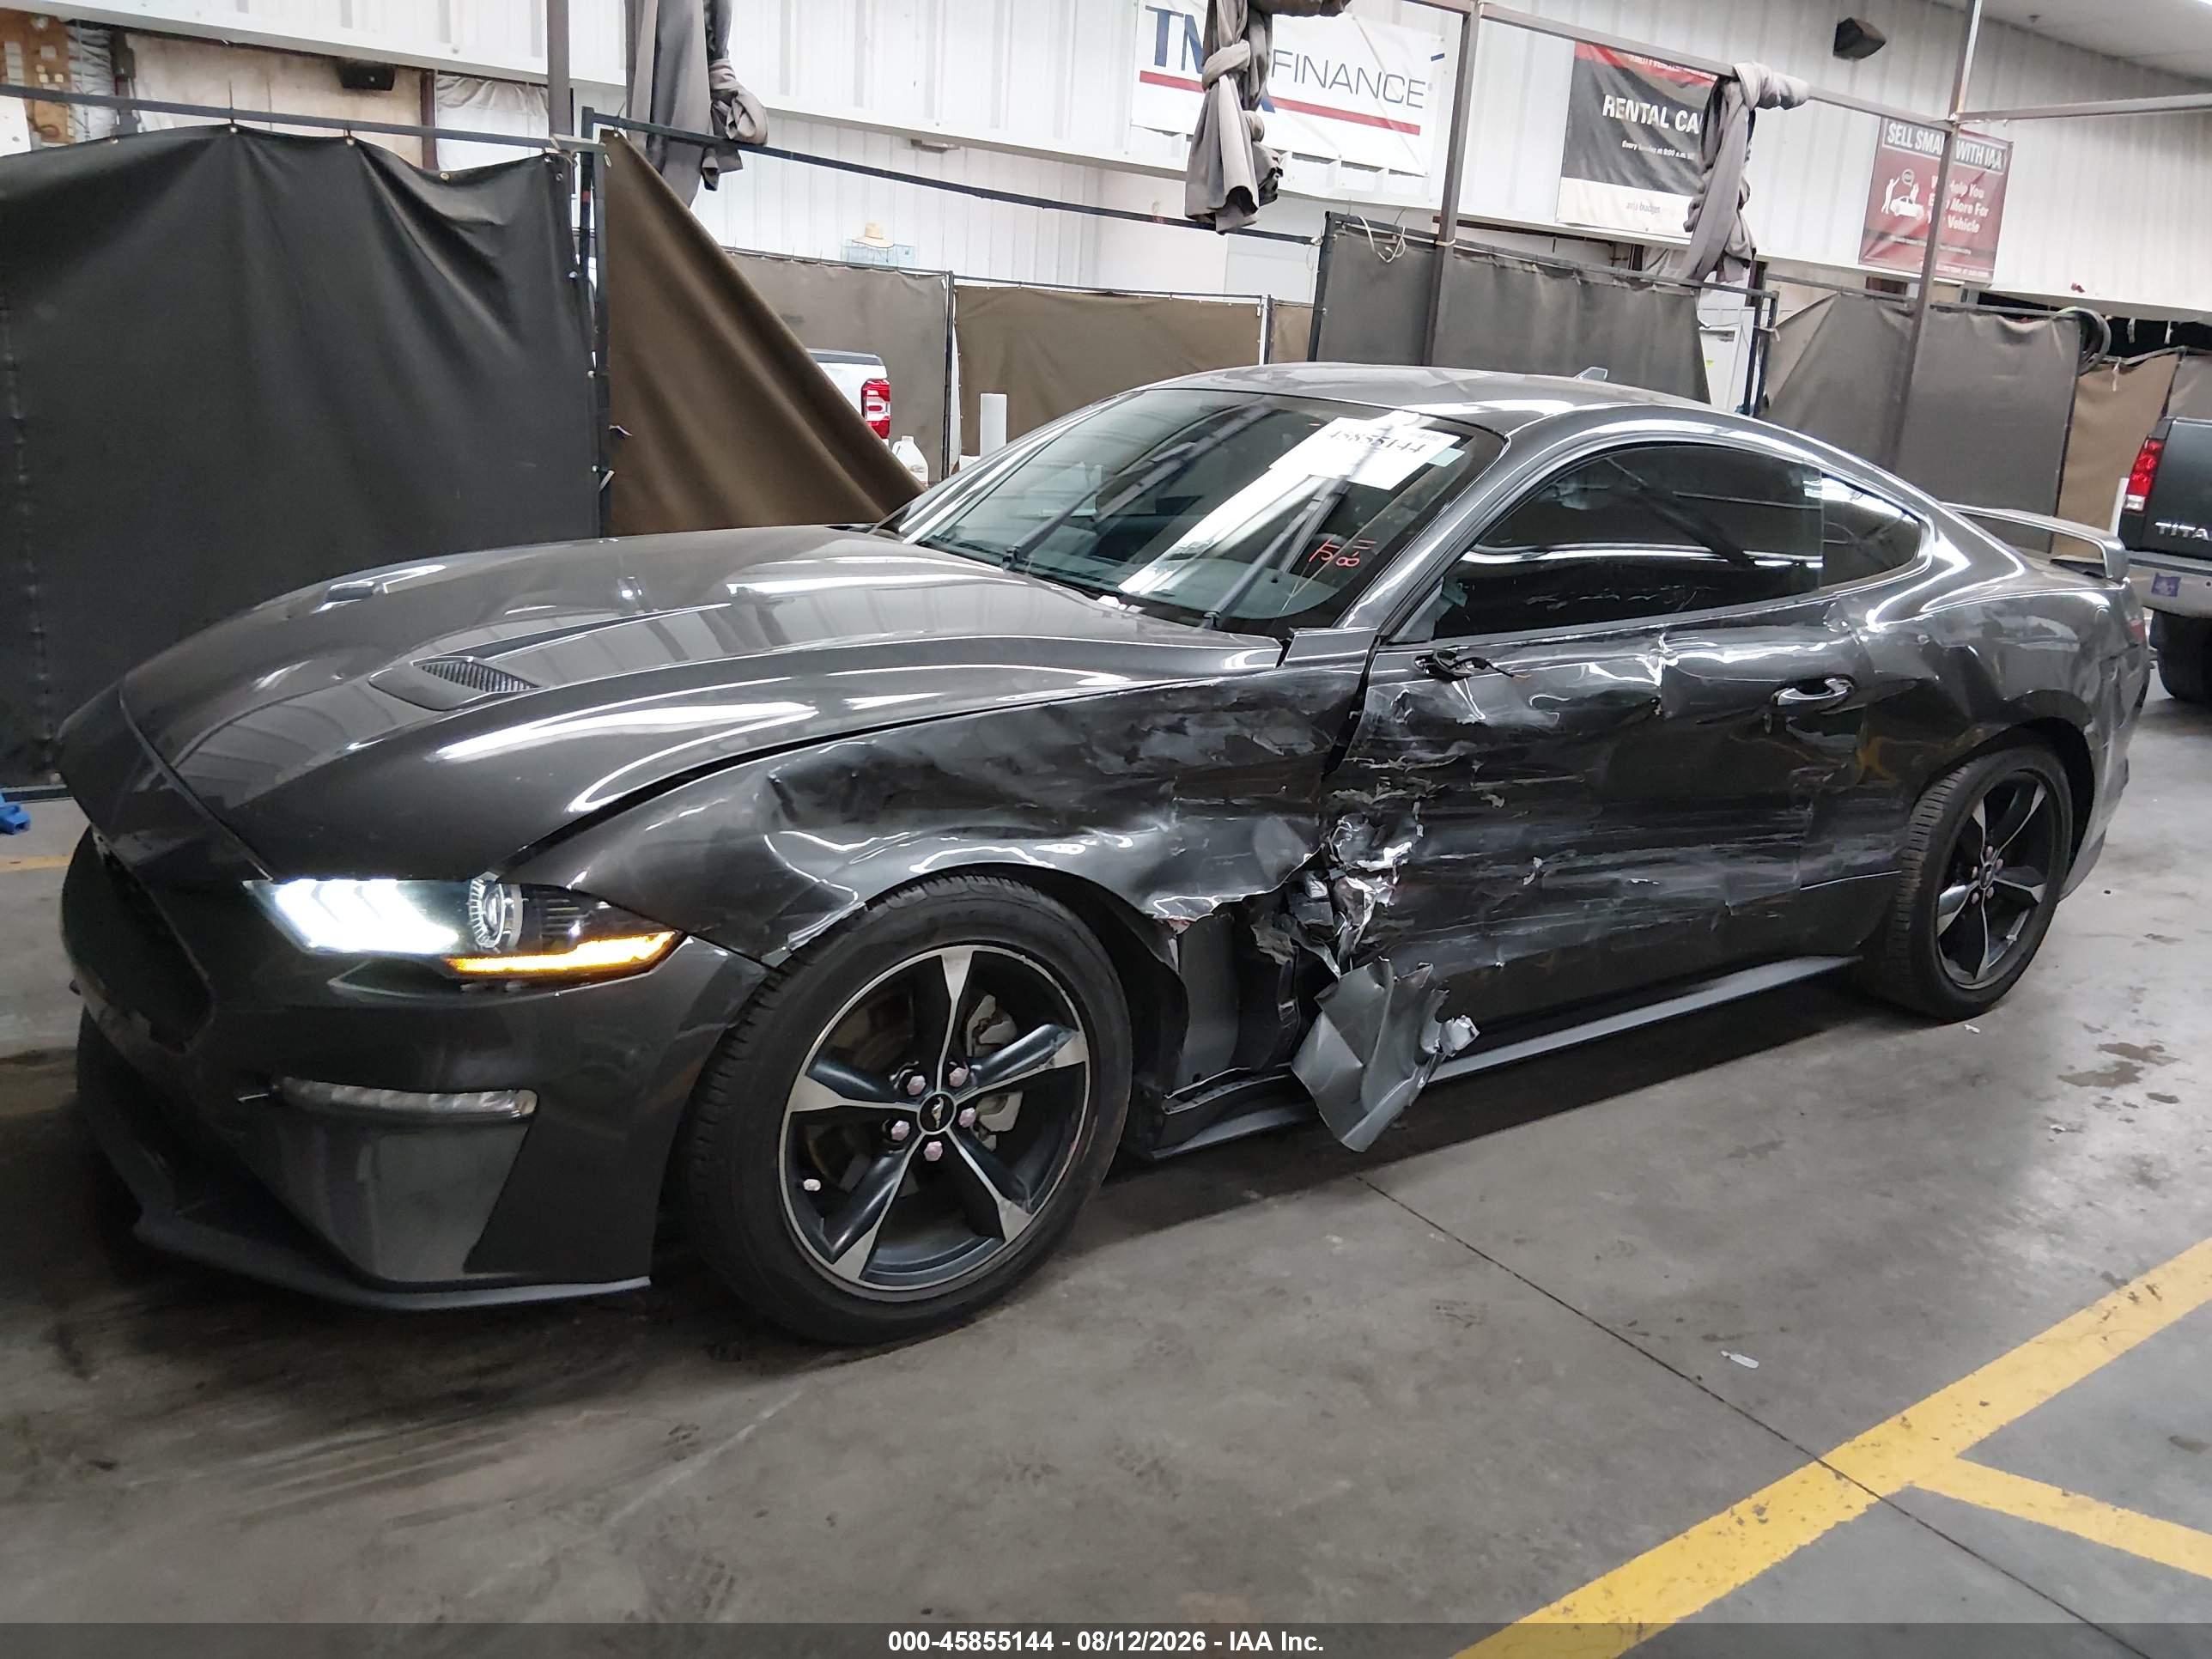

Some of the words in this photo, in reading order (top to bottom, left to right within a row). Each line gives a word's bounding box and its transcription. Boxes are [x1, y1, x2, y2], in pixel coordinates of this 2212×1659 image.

[1271, 48, 1426, 109] FINANCE
[1602, 94, 1668, 128] RENTAL
[1674, 109, 1703, 134] CA
[1887, 123, 1912, 148] SELL
[1915, 130, 1945, 155] SMA
[1955, 140, 1984, 165] WITH
[1984, 146, 2002, 170] IAA
[1969, 183, 1984, 199] You
[1949, 198, 1974, 215] More
[1974, 202, 1990, 217] For
[1948, 215, 1981, 234] Vehicle
